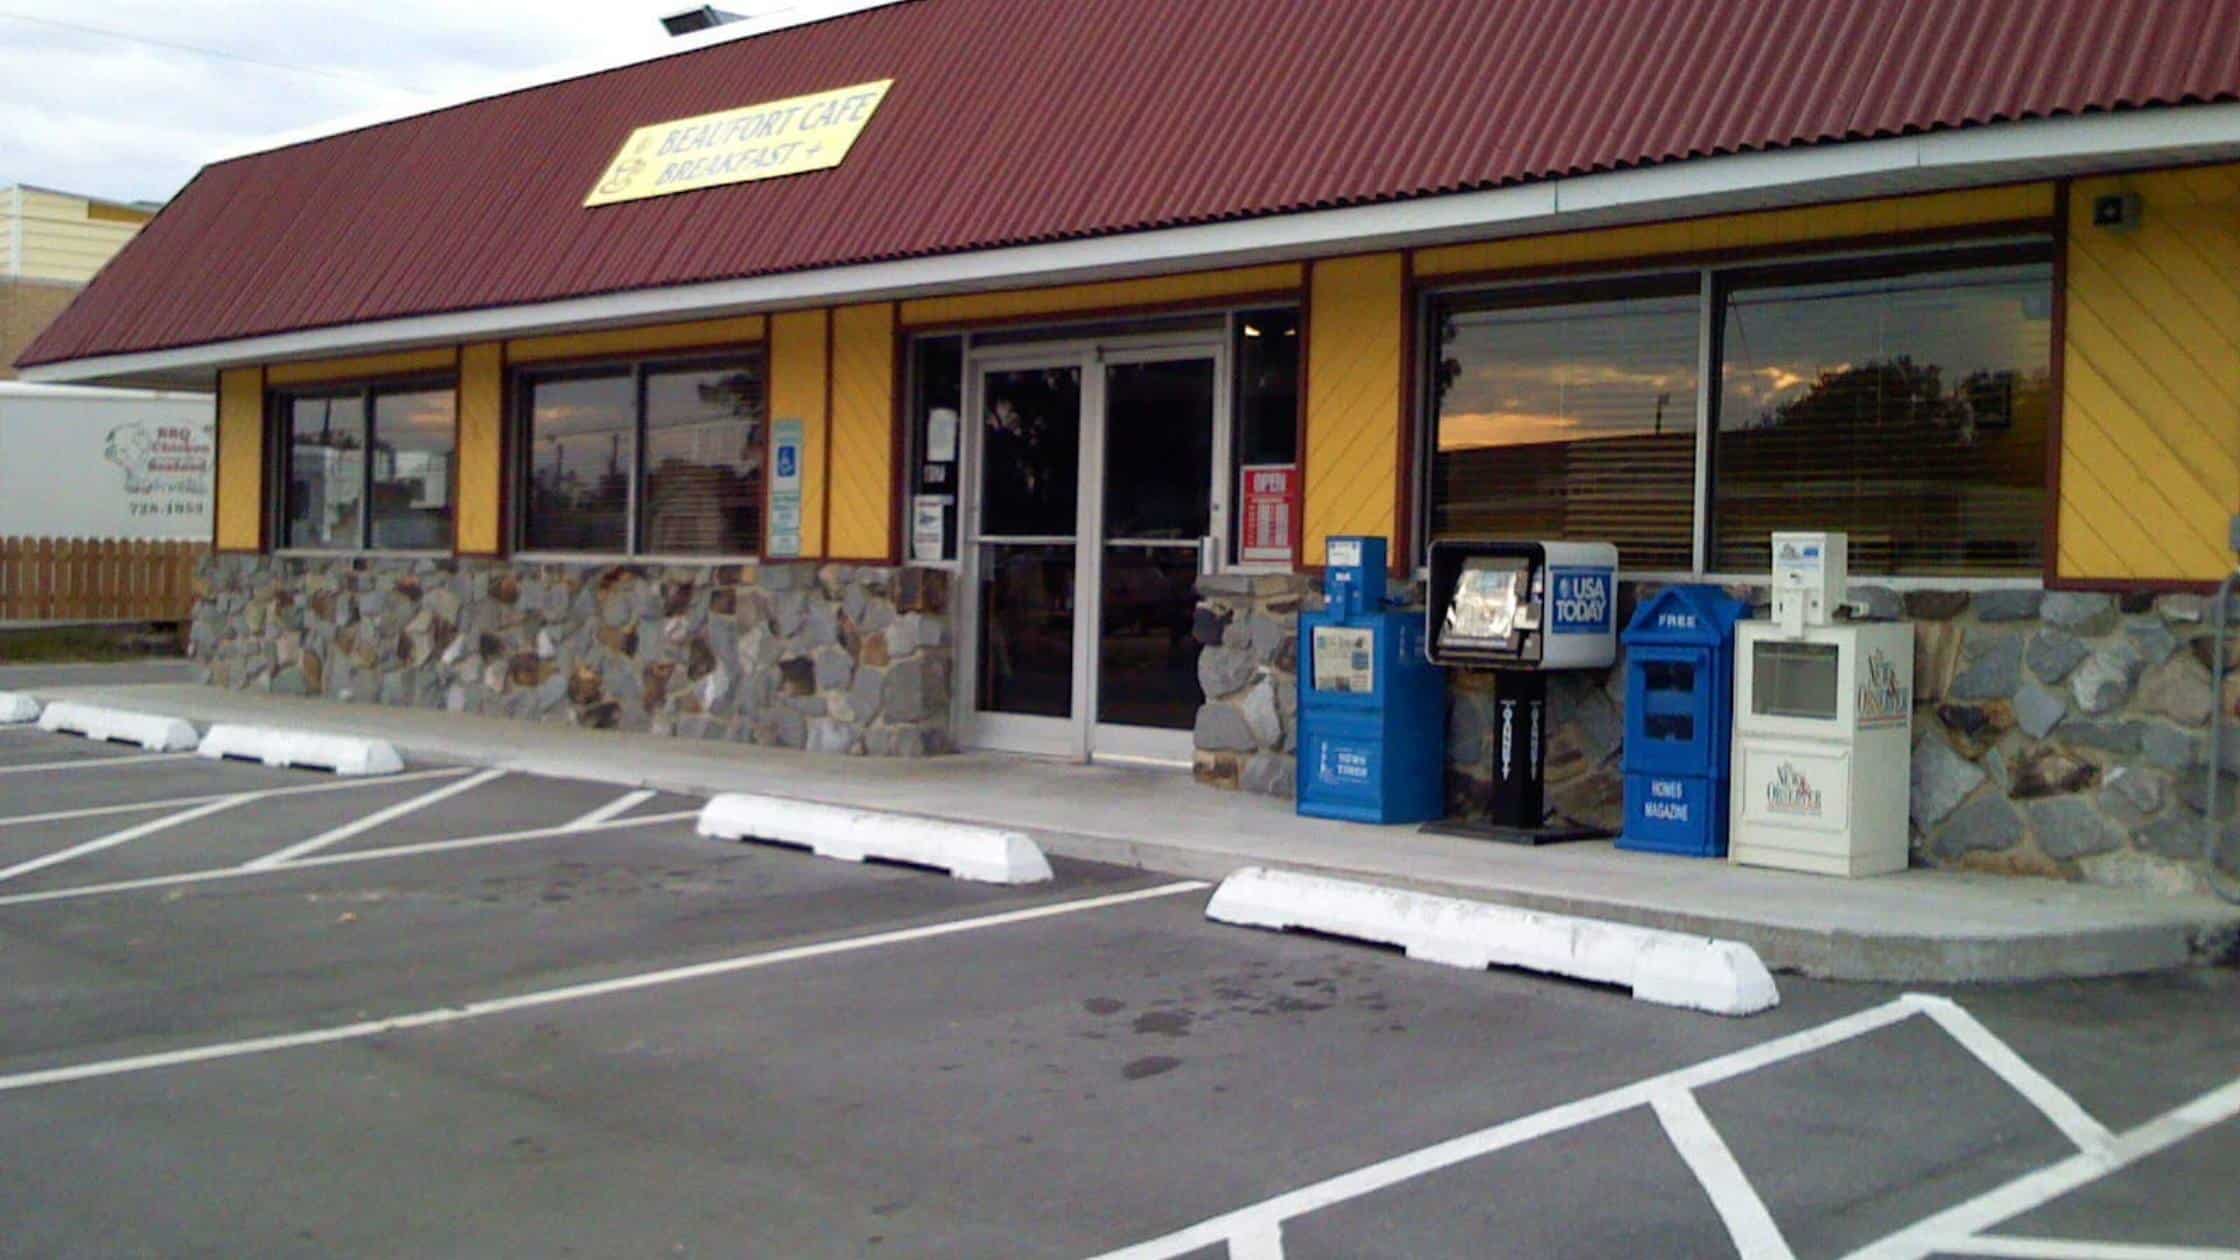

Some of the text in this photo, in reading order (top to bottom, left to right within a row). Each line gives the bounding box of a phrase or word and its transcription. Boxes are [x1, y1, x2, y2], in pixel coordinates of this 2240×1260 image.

[656, 91, 878, 157] BEAUFORT CAFE
[655, 141, 802, 186] BREAKFAST
[1573, 577, 1606, 599] USA
[1555, 598, 1607, 623] TODAY
[1658, 614, 1697, 629] FREE
[1651, 780, 1683, 799] HOMES
[1644, 803, 1689, 822] MAGAZINE
